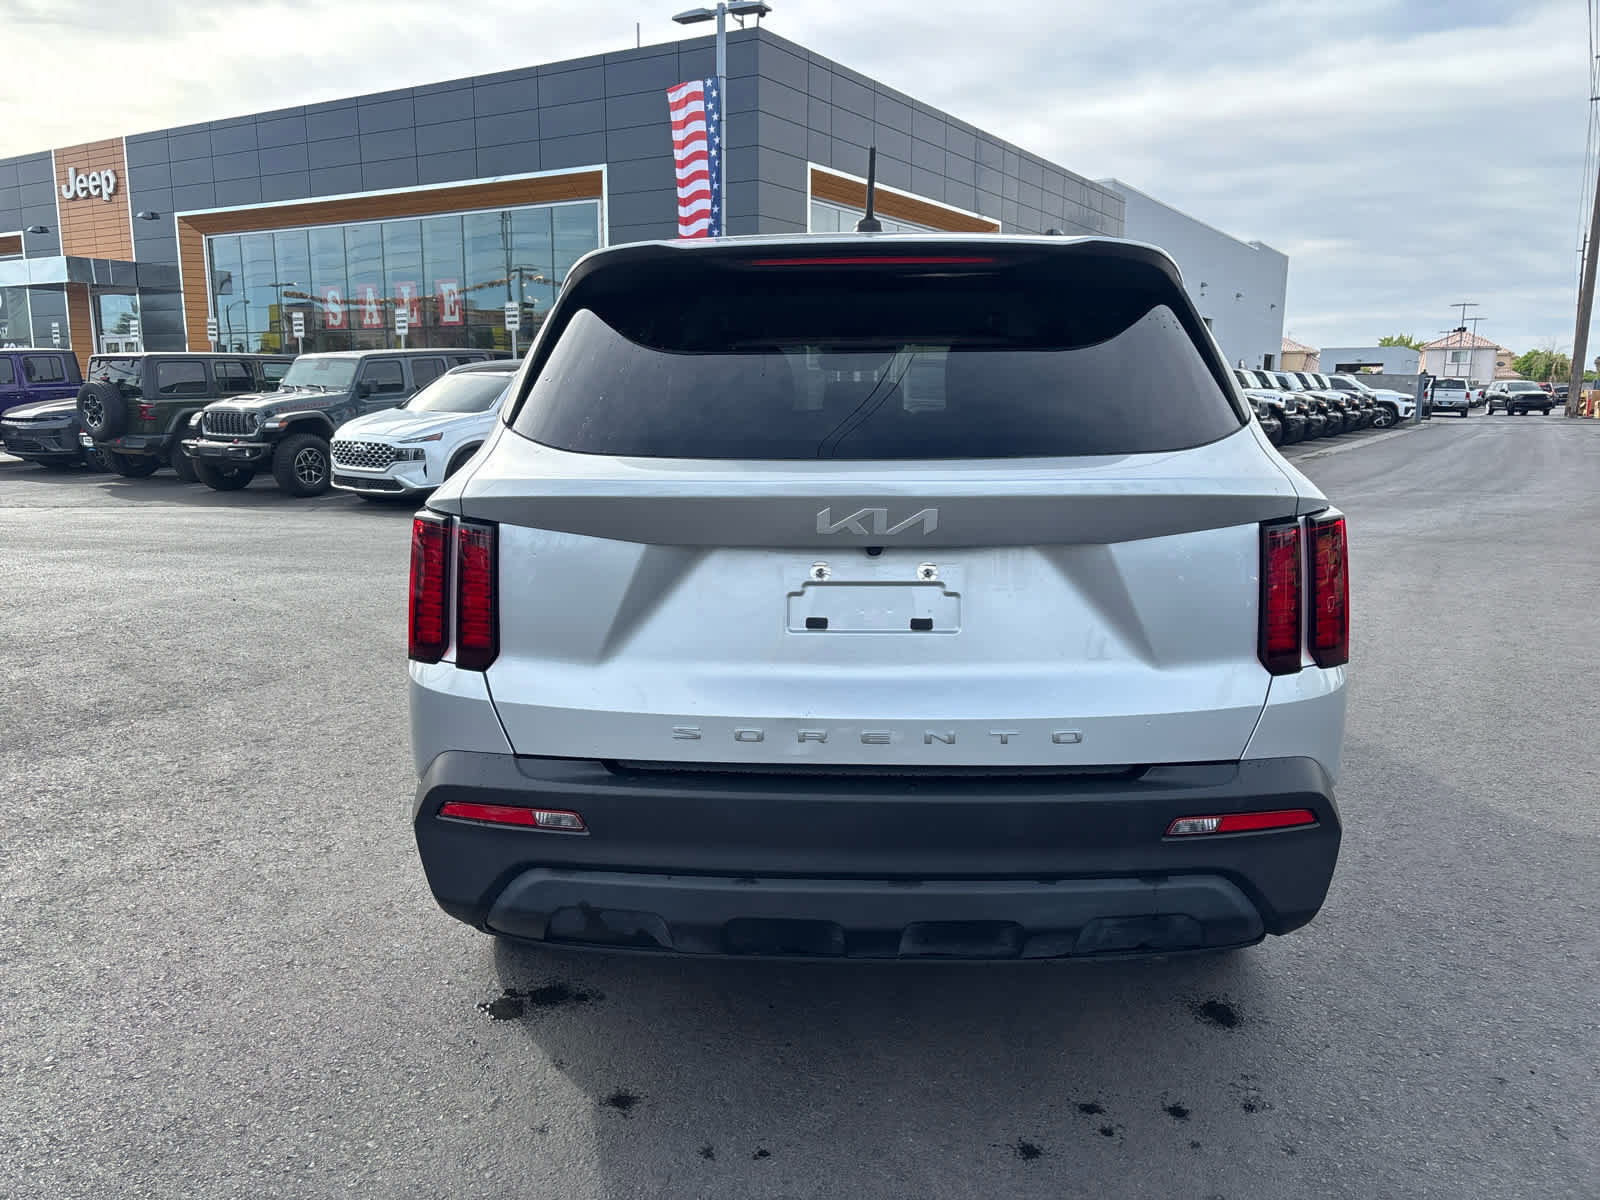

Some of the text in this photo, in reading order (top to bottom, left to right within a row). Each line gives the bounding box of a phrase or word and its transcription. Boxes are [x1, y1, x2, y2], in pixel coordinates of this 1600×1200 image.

[61, 167, 117, 201] Jeep
[326, 283, 460, 326] SALE
[816, 507, 939, 535] KIA
[671, 725, 1084, 745] SORENTO
